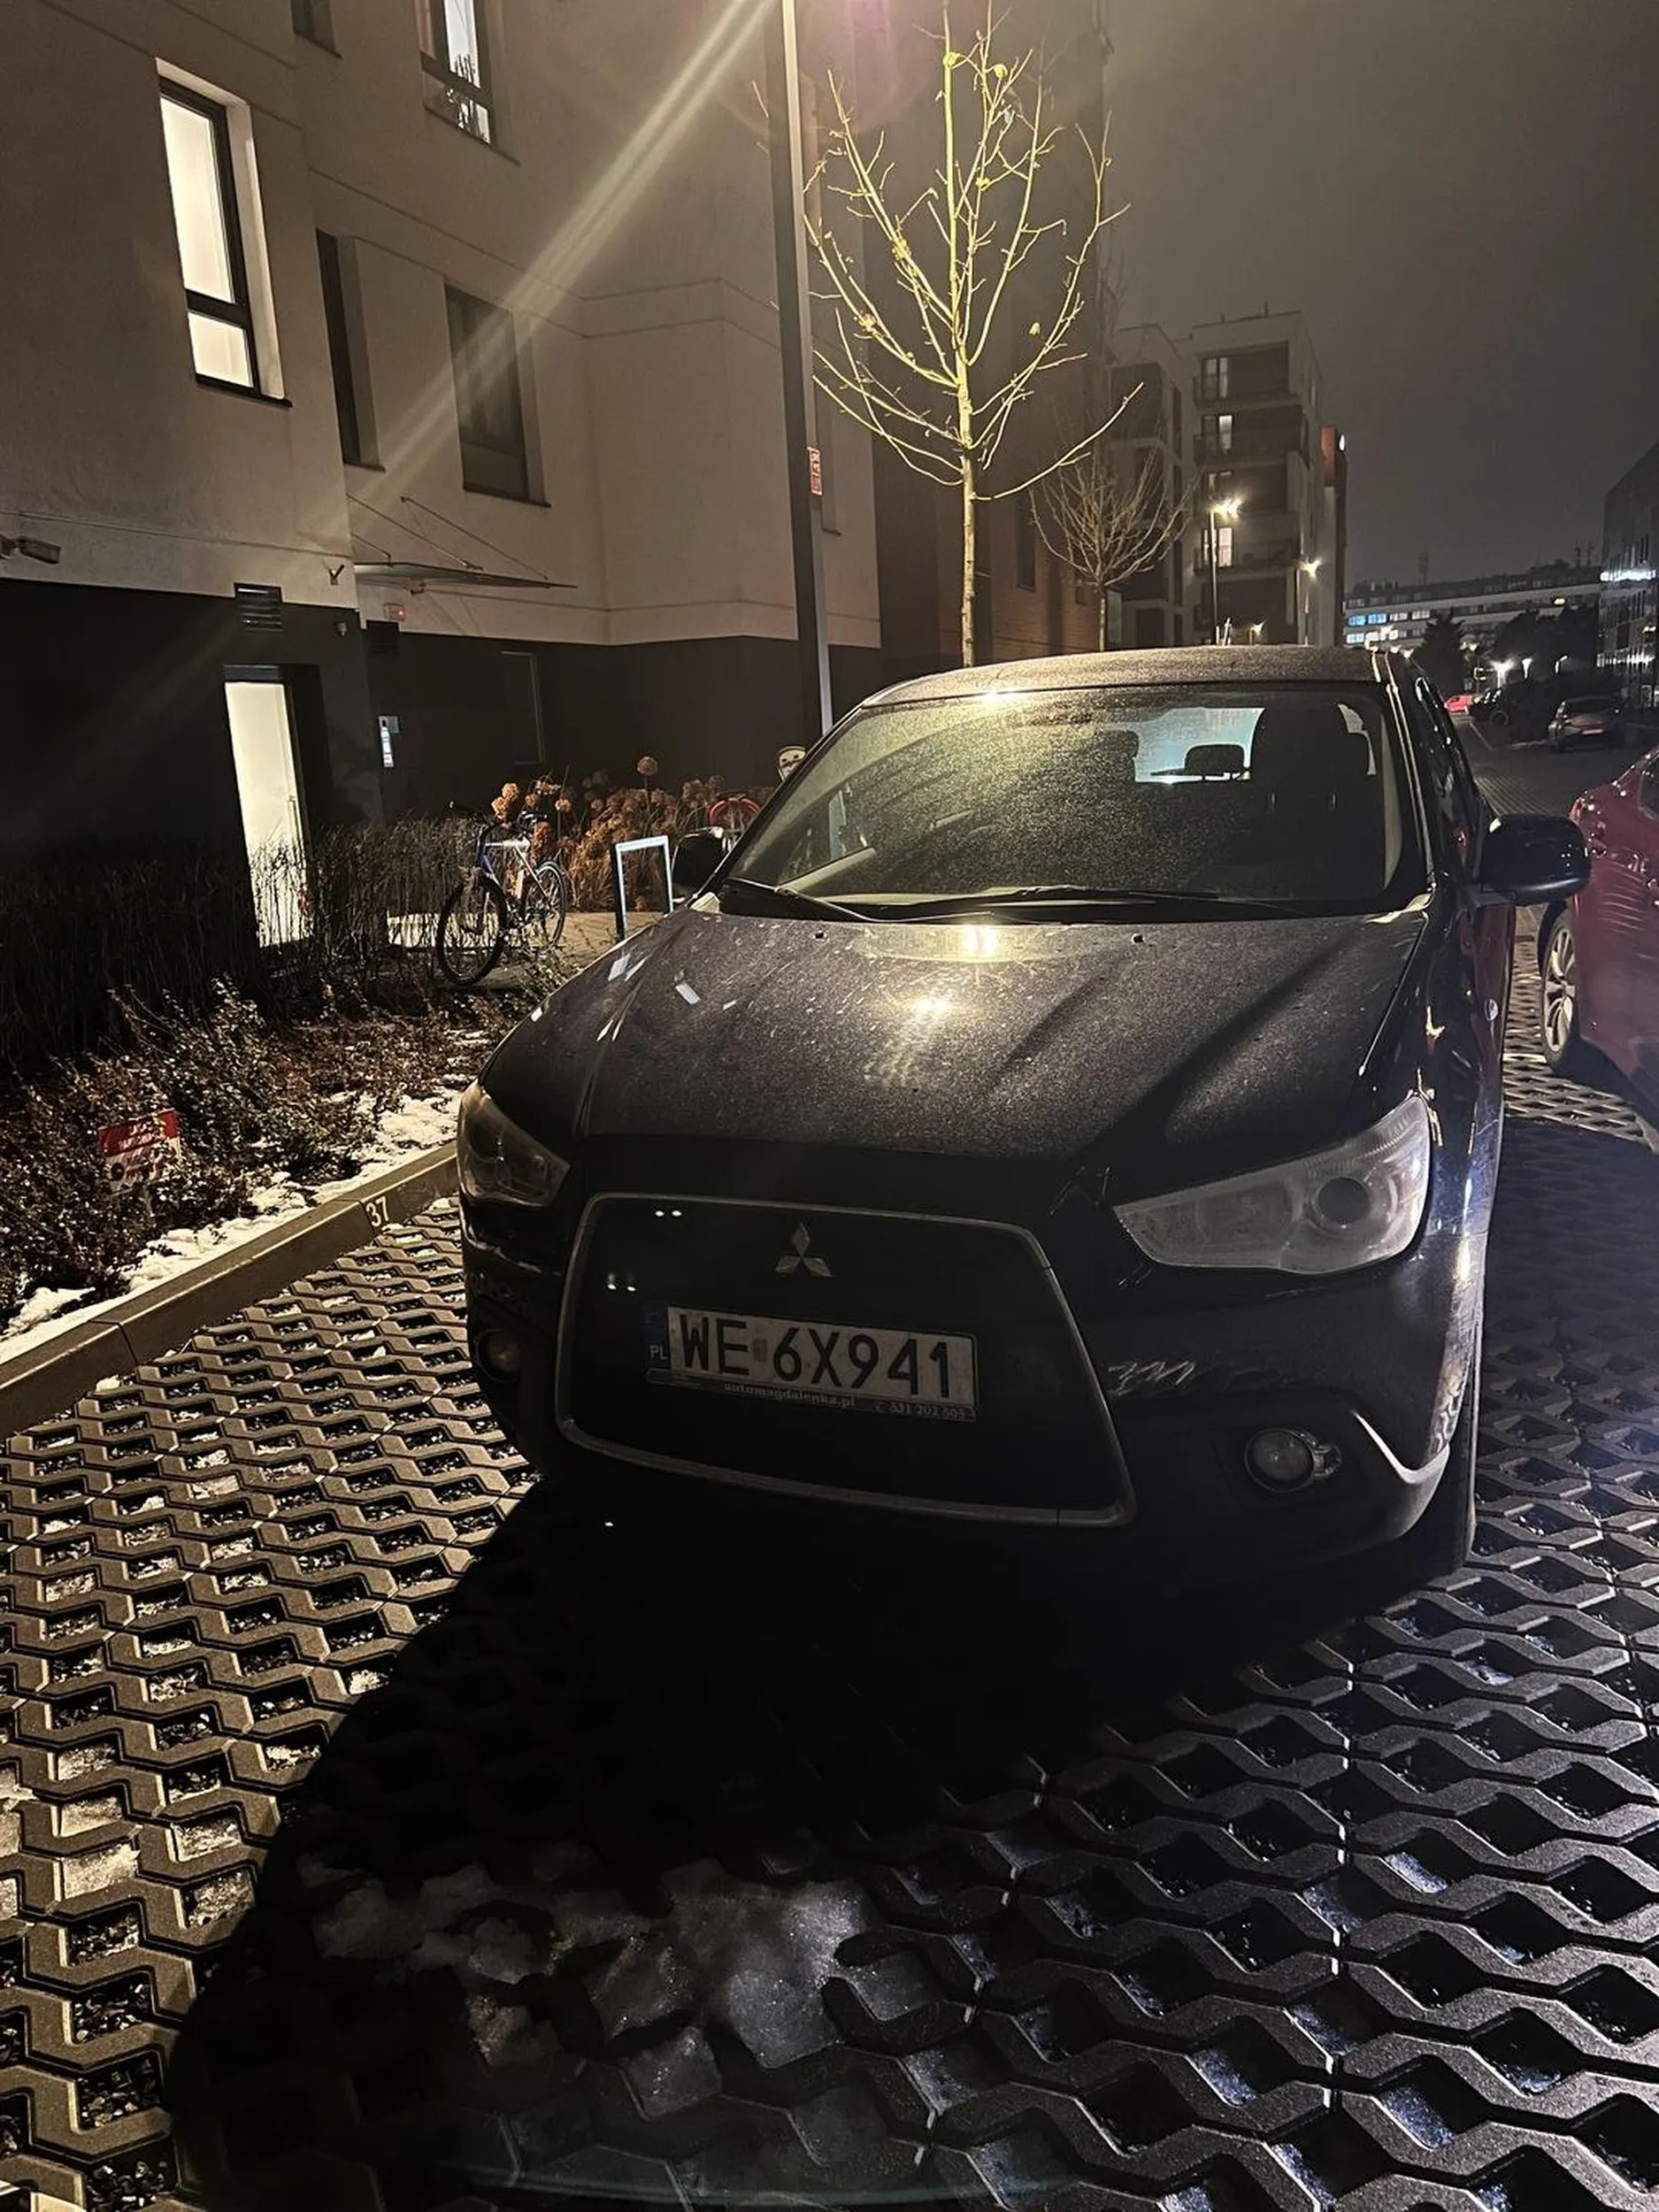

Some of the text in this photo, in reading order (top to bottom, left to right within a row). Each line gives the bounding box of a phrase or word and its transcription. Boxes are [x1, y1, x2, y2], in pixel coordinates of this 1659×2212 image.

[365, 1195, 389, 1227] 37
[649, 1344, 668, 1361] PL
[680, 1314, 950, 1399] WE 6X941
